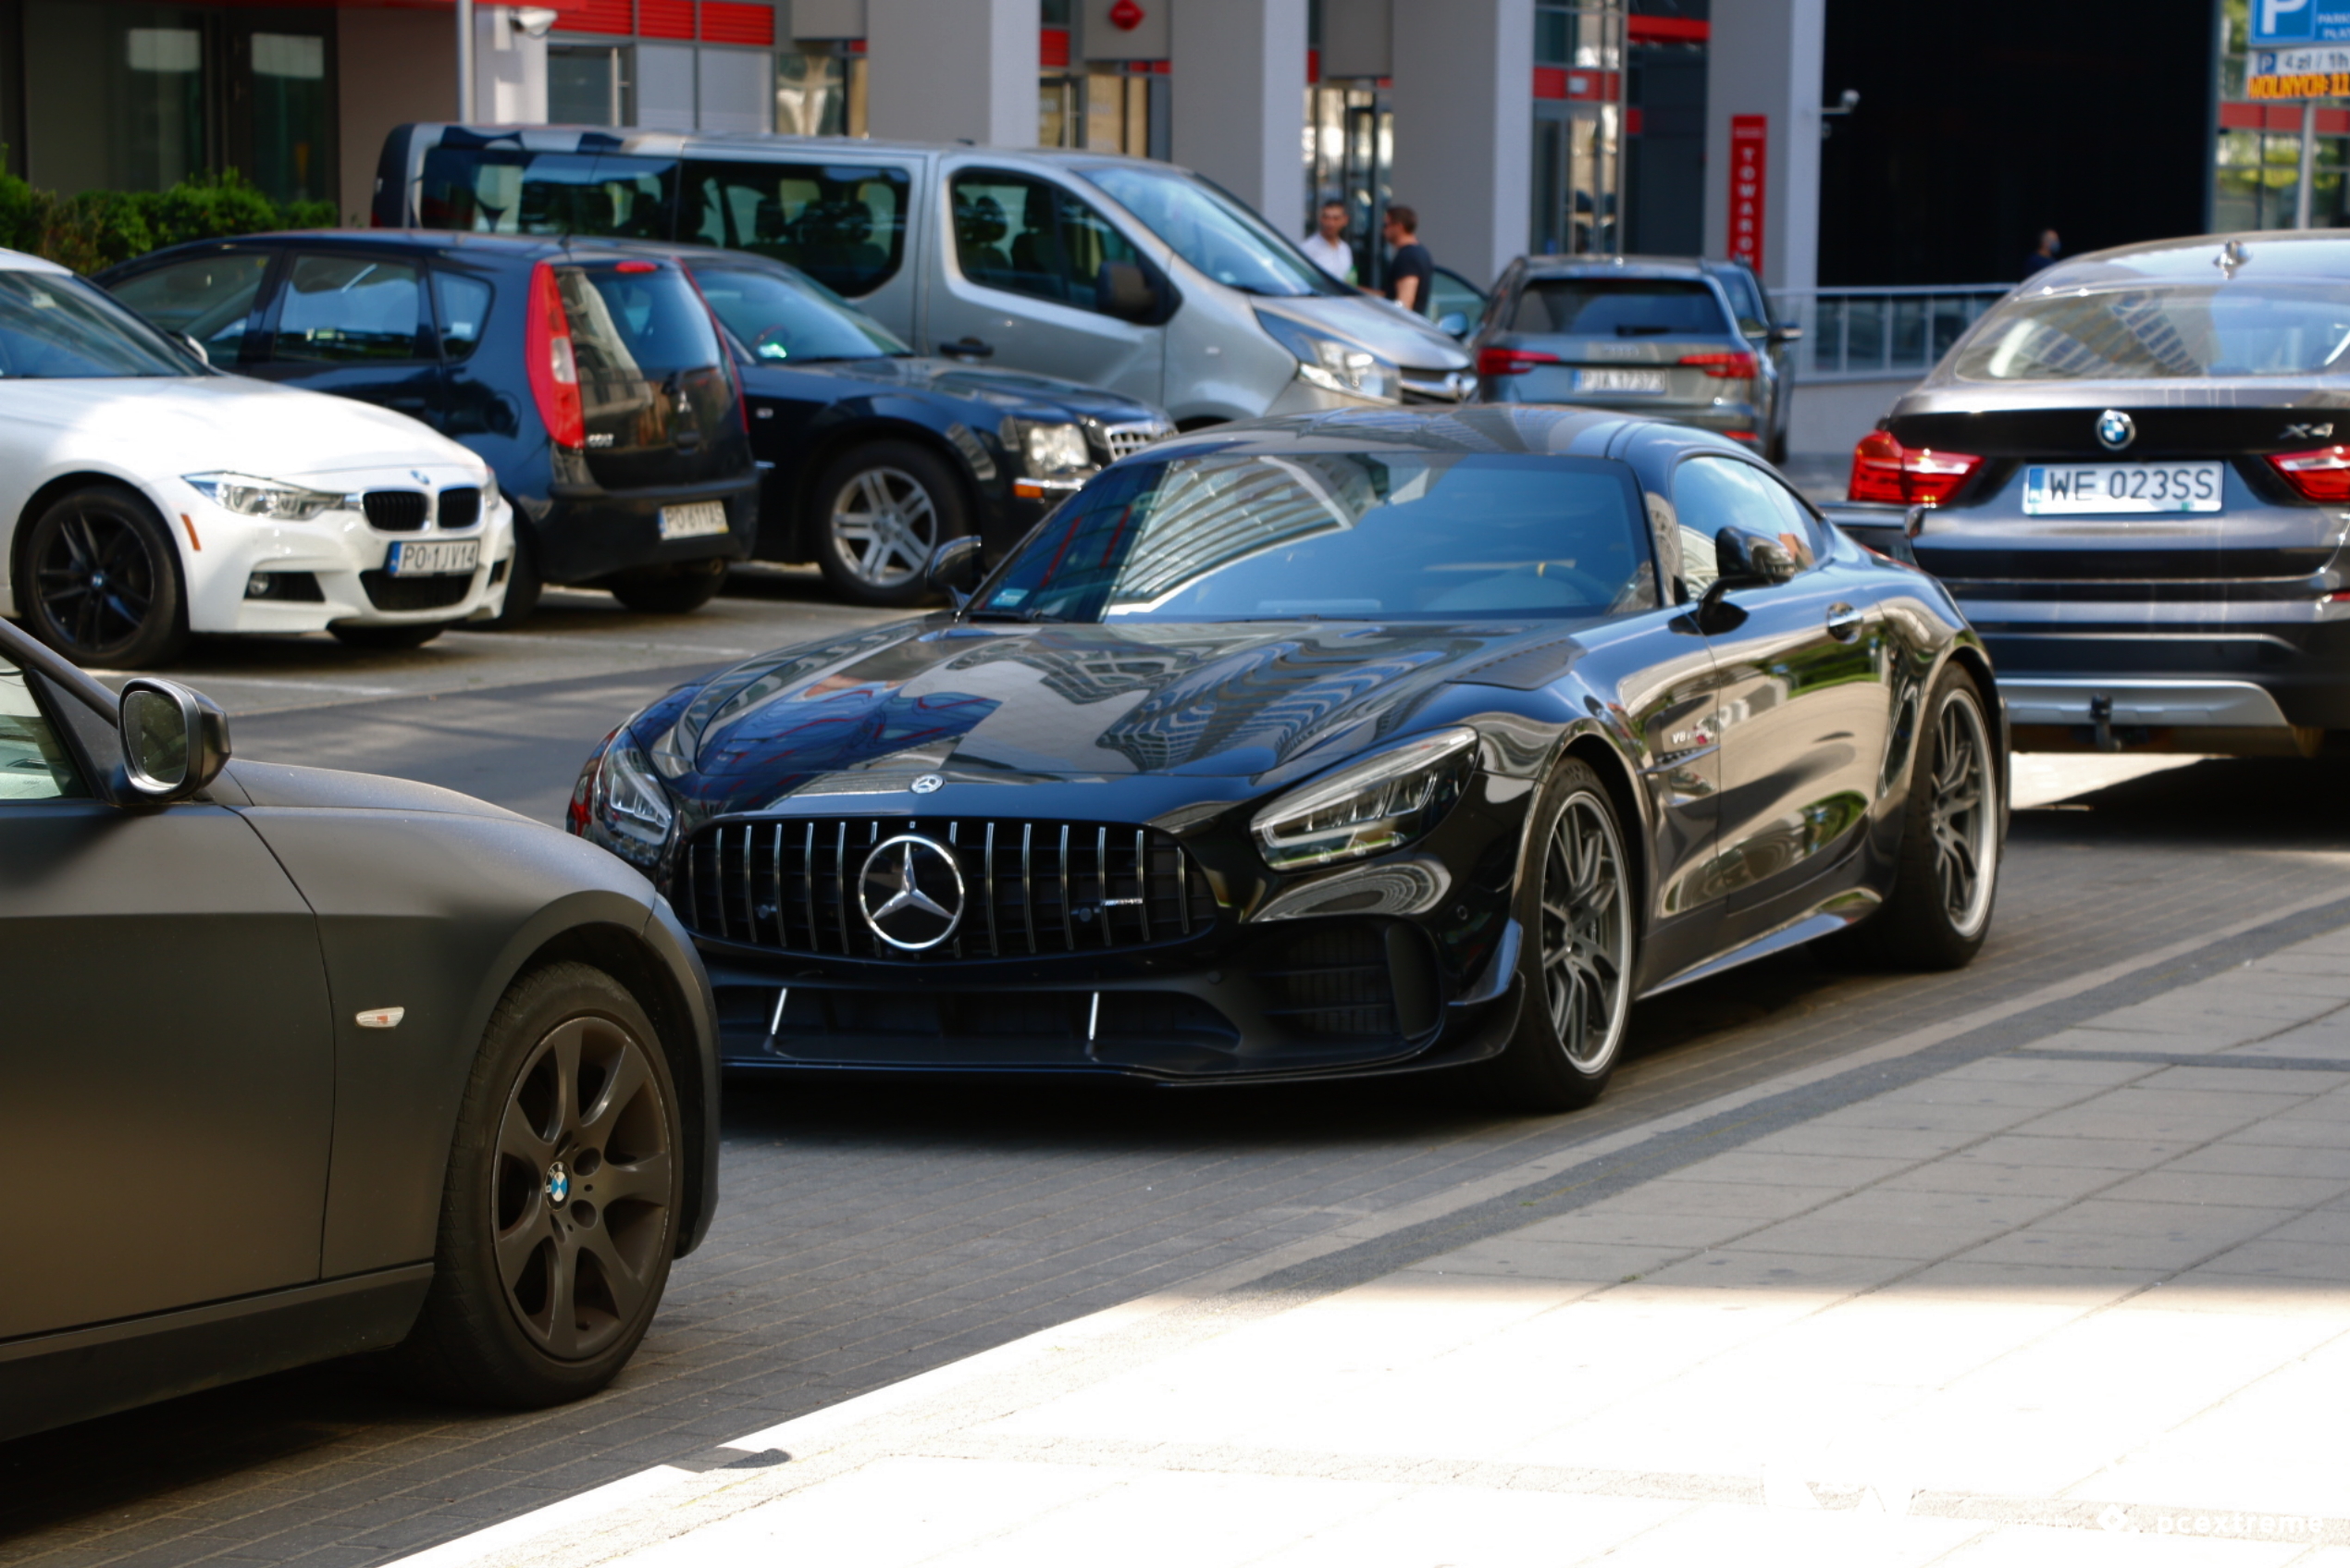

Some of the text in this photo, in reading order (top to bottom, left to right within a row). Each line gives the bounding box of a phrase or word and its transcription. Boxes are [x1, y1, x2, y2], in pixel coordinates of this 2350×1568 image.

[2049, 469, 2214, 501] WE 023SS
[402, 544, 427, 569] PO
